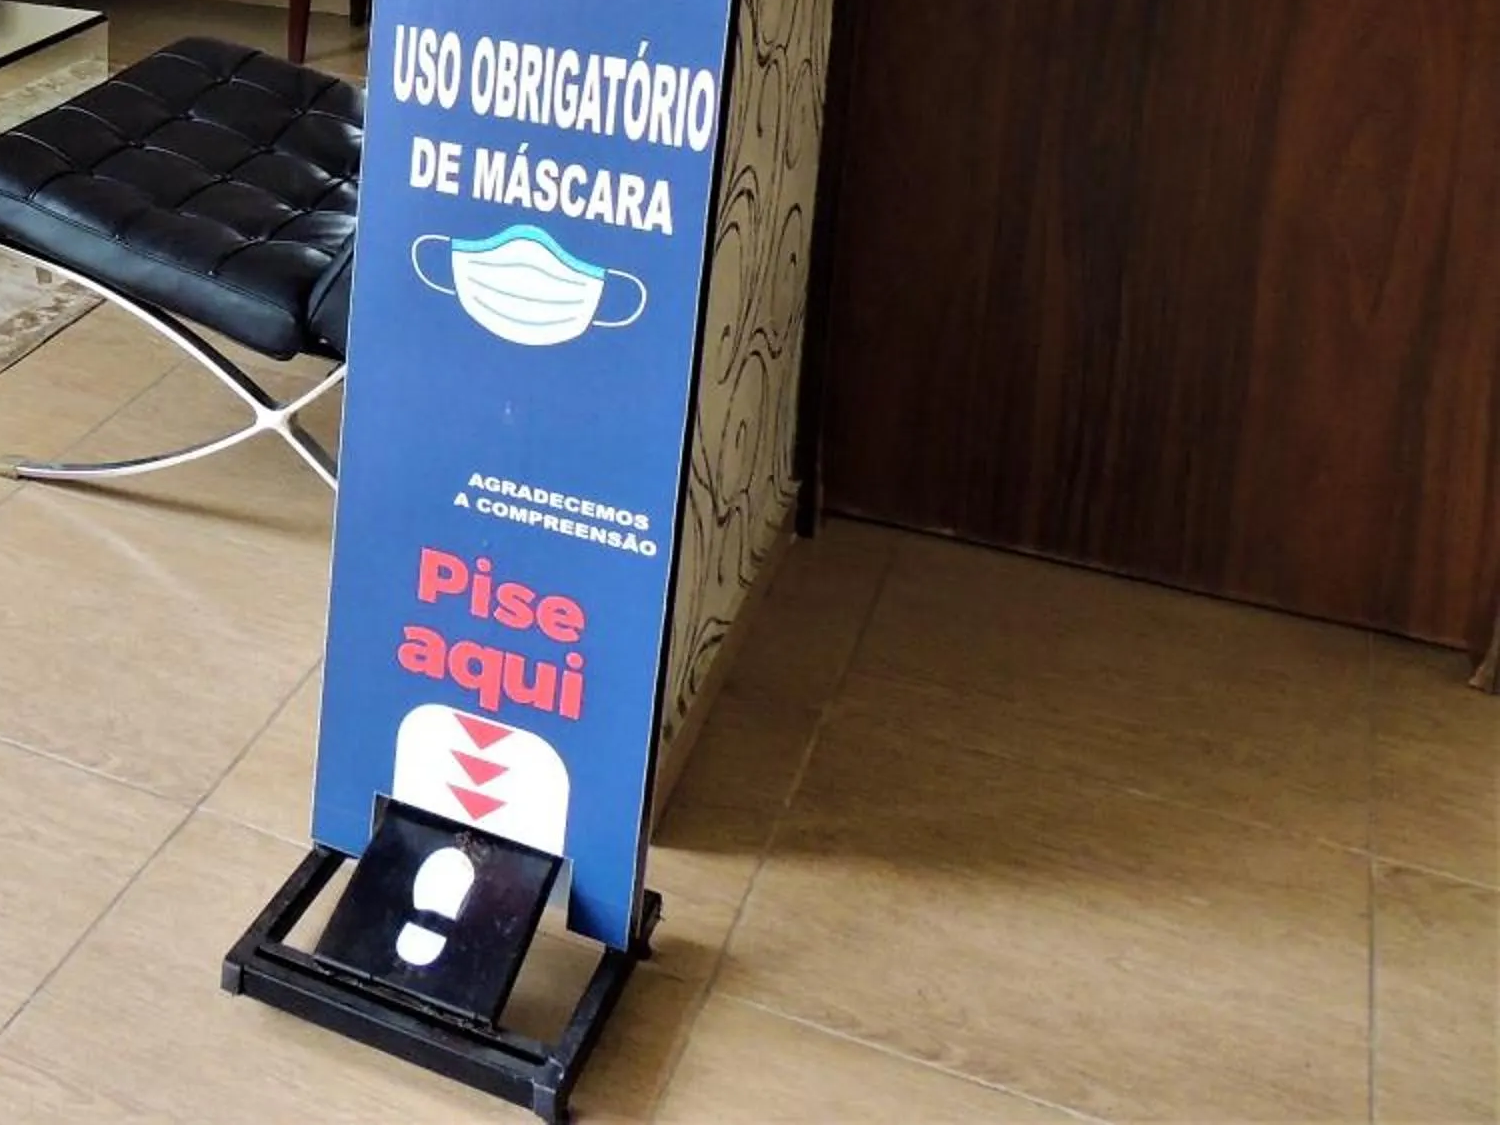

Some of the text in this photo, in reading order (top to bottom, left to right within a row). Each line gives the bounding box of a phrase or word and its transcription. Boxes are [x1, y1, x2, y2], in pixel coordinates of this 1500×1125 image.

[393, 24, 716, 153] USO OBRIGATÓRIO
[410, 135, 674, 236] DE MÁSCARA
[454, 492, 658, 557] A COMPREENSÃO
[468, 472, 650, 531] AGRADECEMOS
[417, 546, 586, 643] Pise
[397, 624, 584, 721] aqui
